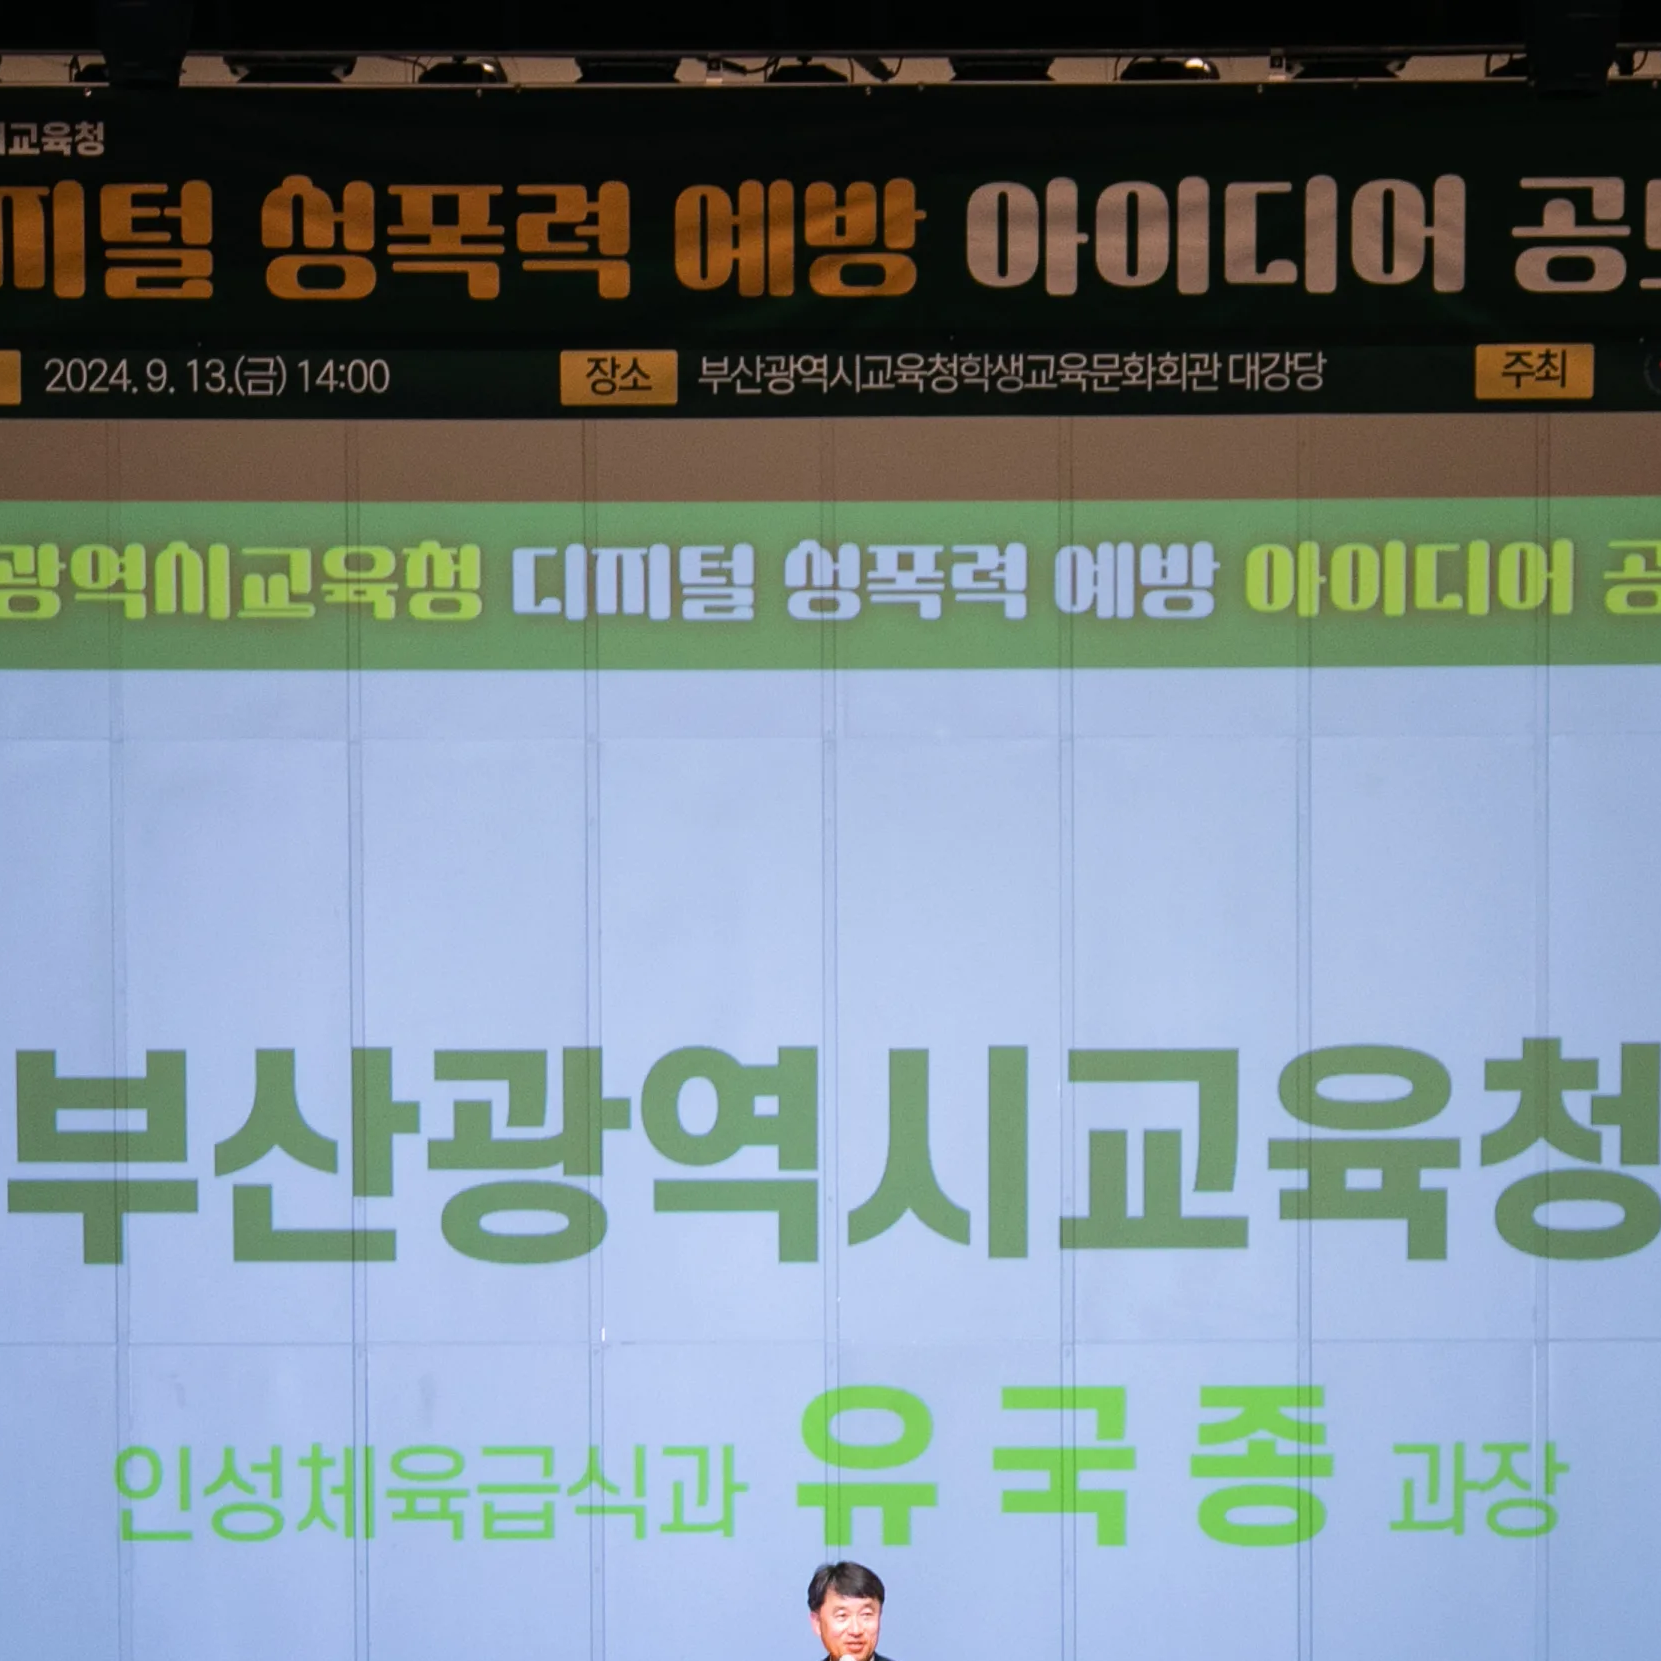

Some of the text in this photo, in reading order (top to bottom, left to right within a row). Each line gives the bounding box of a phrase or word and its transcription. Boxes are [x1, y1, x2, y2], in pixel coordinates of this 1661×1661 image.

[260, 174, 631, 300] 성폭력
[674, 177, 927, 298] 예방
[966, 174, 1467, 295] 아이디어
[297, 358, 390, 394] 14:00
[585, 356, 654, 397] 장소
[697, 351, 1327, 395] 부산광역시교육청학생교육문화회관 대강당
[1500, 350, 1568, 390] 주최
[510, 540, 756, 622] 디지털
[783, 538, 1029, 622] 성폭력
[1053, 538, 1221, 621] 예방
[1243, 537, 1576, 618] 아이디어
[112, 1440, 751, 1544] 인성체육급식과
[1388, 1438, 1571, 1540] 과장
